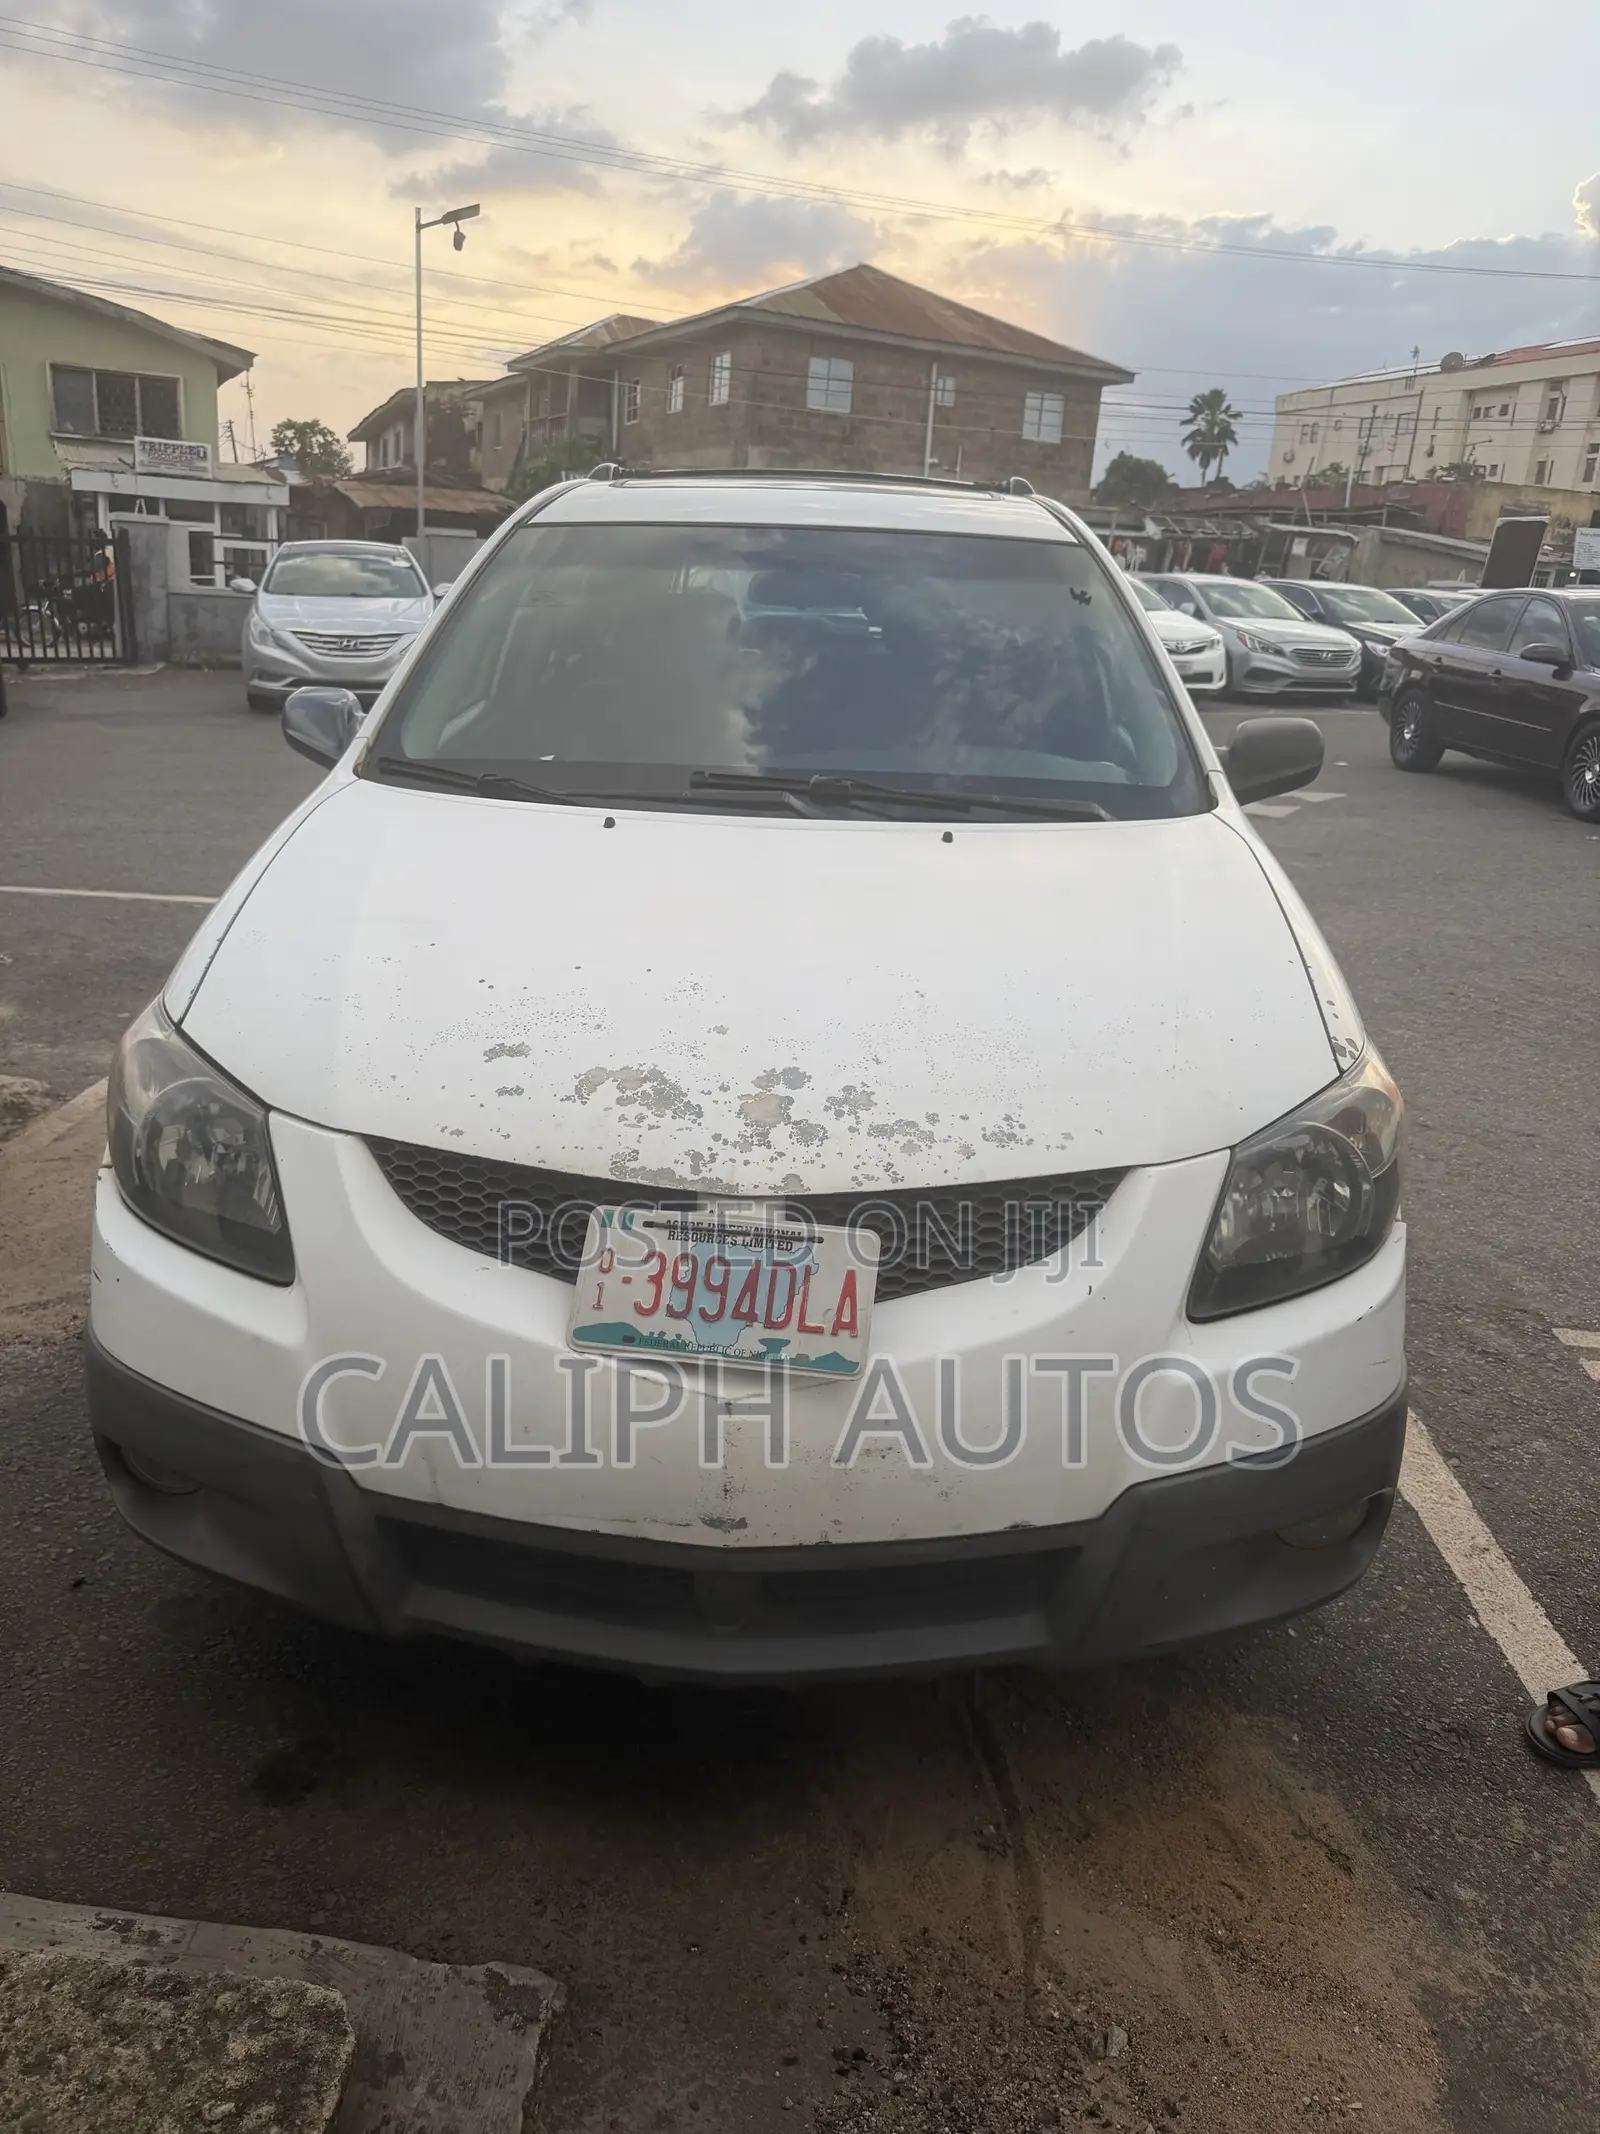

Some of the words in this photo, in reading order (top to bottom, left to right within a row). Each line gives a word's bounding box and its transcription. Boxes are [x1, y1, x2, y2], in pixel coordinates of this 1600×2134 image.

[140, 441, 196, 455] TRIPPLE
[667, 1230, 738, 1246] RESOURCES
[740, 1237, 793, 1252] LIMITED
[638, 1337, 683, 1350] FEDERAL
[684, 1340, 733, 1356] REPUBLIC
[733, 1348, 747, 1358] OF
